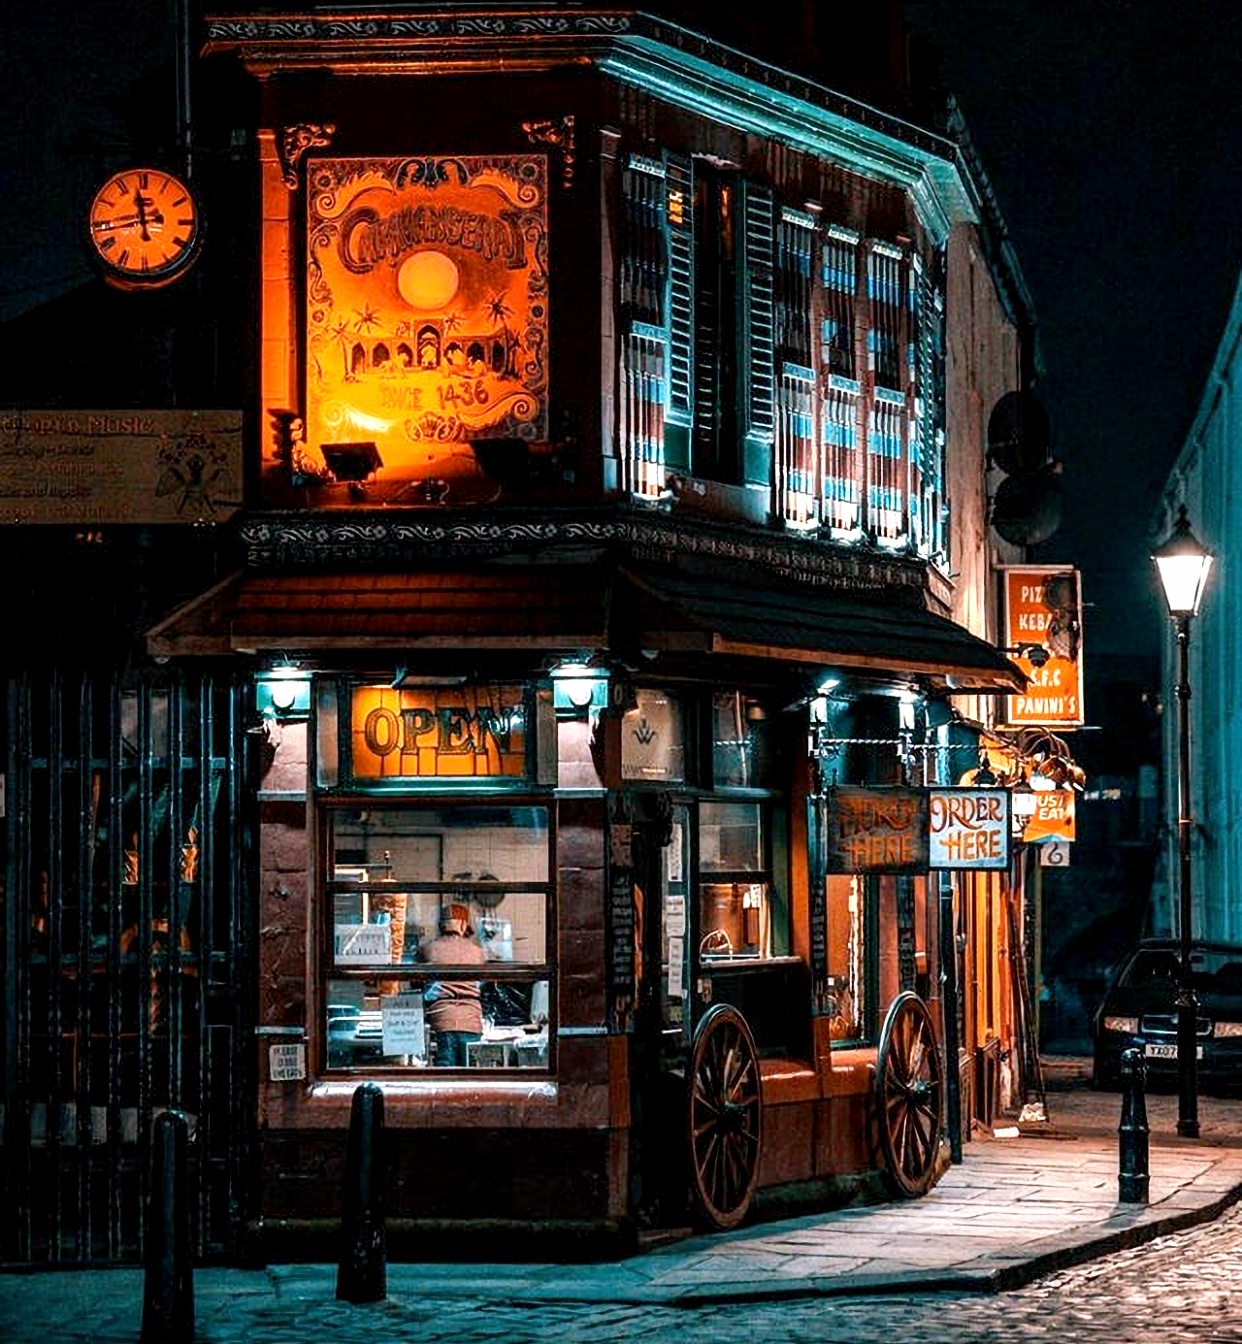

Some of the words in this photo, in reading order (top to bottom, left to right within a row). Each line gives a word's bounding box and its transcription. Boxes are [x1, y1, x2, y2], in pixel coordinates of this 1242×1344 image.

[436, 379, 489, 411] 1436
[1021, 586, 1043, 603] PIZ
[1016, 696, 1076, 715] PANINI'S
[364, 706, 522, 756] OPEN
[930, 796, 1004, 833] ORDER
[1038, 807, 1065, 821] EAT
[939, 829, 1002, 861] HERE
